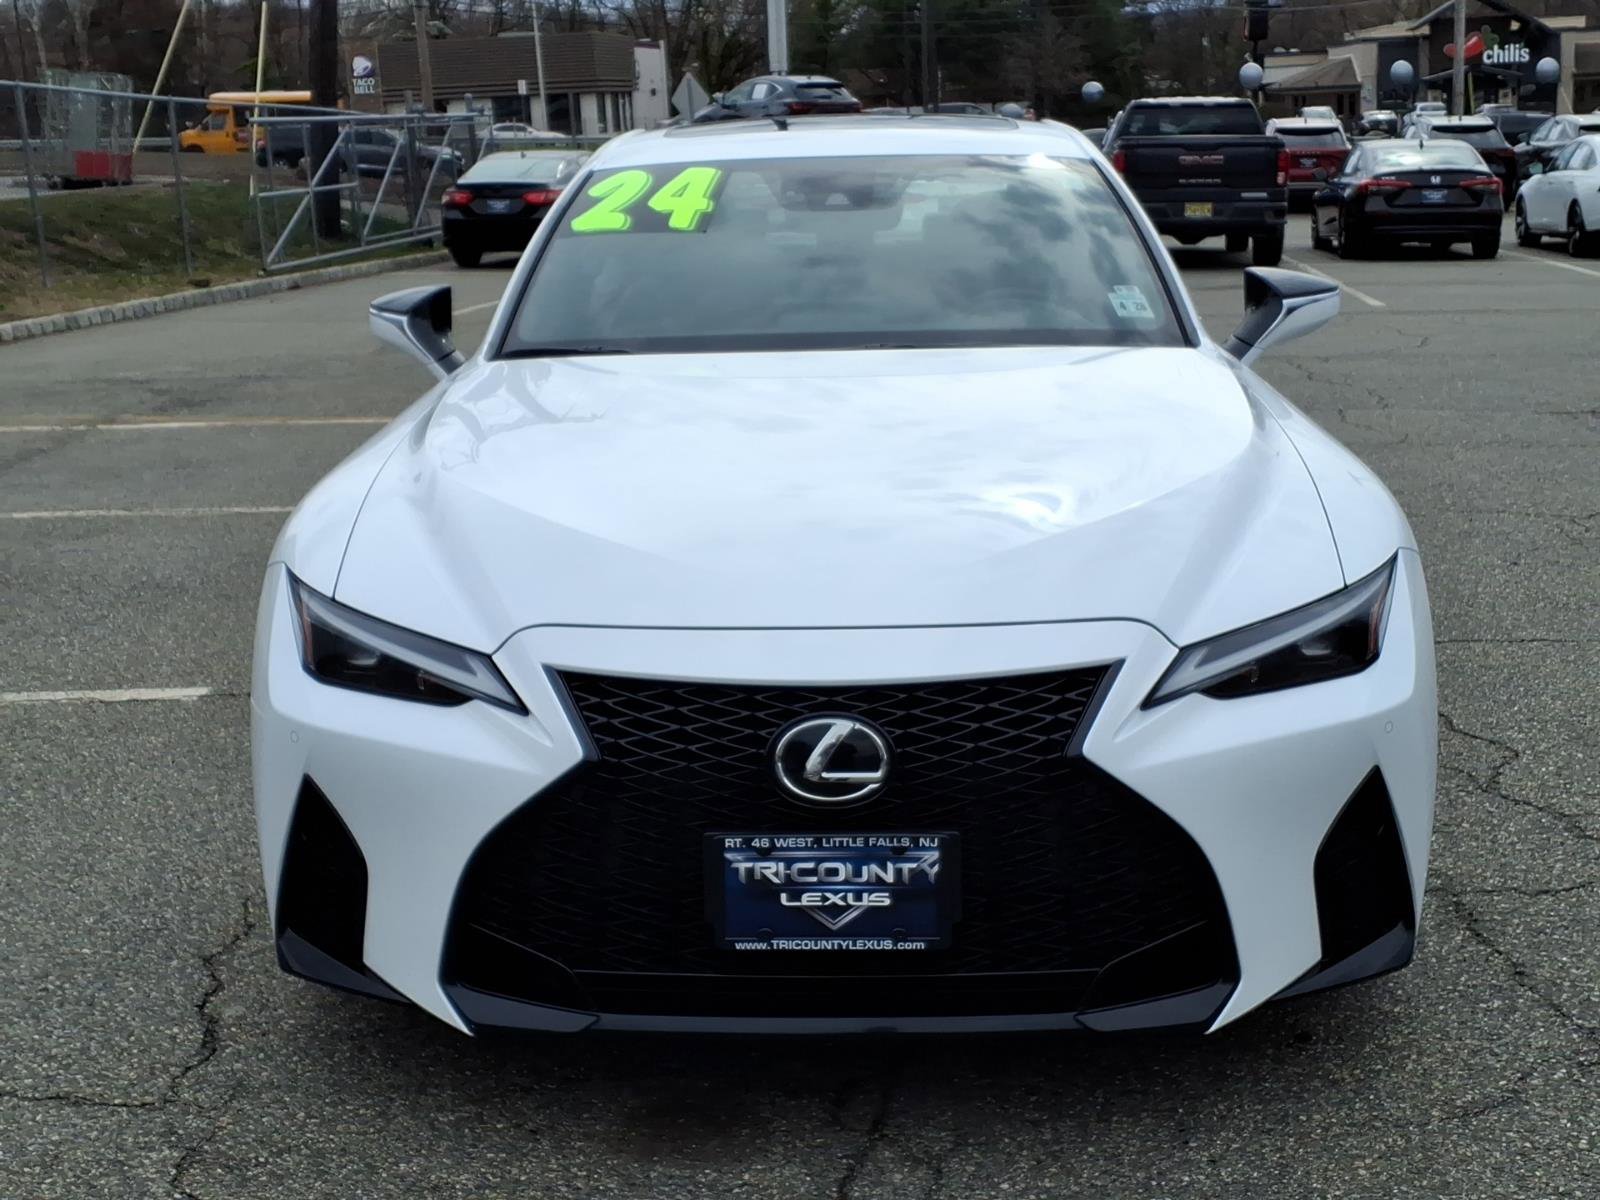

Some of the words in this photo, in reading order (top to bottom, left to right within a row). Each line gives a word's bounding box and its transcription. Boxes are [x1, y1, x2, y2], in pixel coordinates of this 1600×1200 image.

[352, 78, 375, 86] TACO
[354, 86, 375, 94] BELL
[571, 167, 722, 233] 24
[724, 838, 746, 849] RT.
[751, 838, 770, 848] 46
[774, 838, 817, 849] WEST,
[822, 838, 864, 848] LITTLE
[869, 837, 914, 848] FALLS,
[919, 837, 938, 848] NJ
[780, 892, 892, 907] LEXUS
[734, 940, 926, 951] www.TRICOUNTYLEXUS.com
